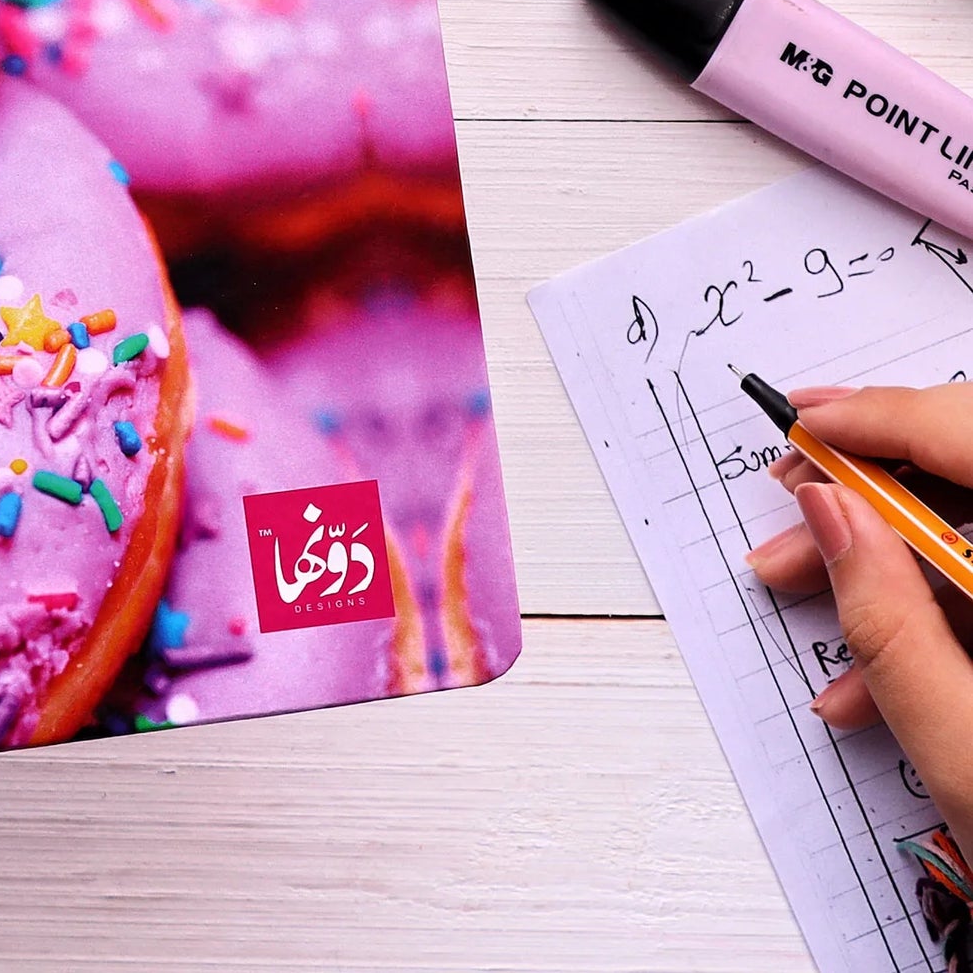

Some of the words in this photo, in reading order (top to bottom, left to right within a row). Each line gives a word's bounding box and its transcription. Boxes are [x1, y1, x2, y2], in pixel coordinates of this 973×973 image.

[779, 41, 835, 87] M&G
[842, 79, 940, 145] POINT
[294, 597, 366, 613] DESIGNS
